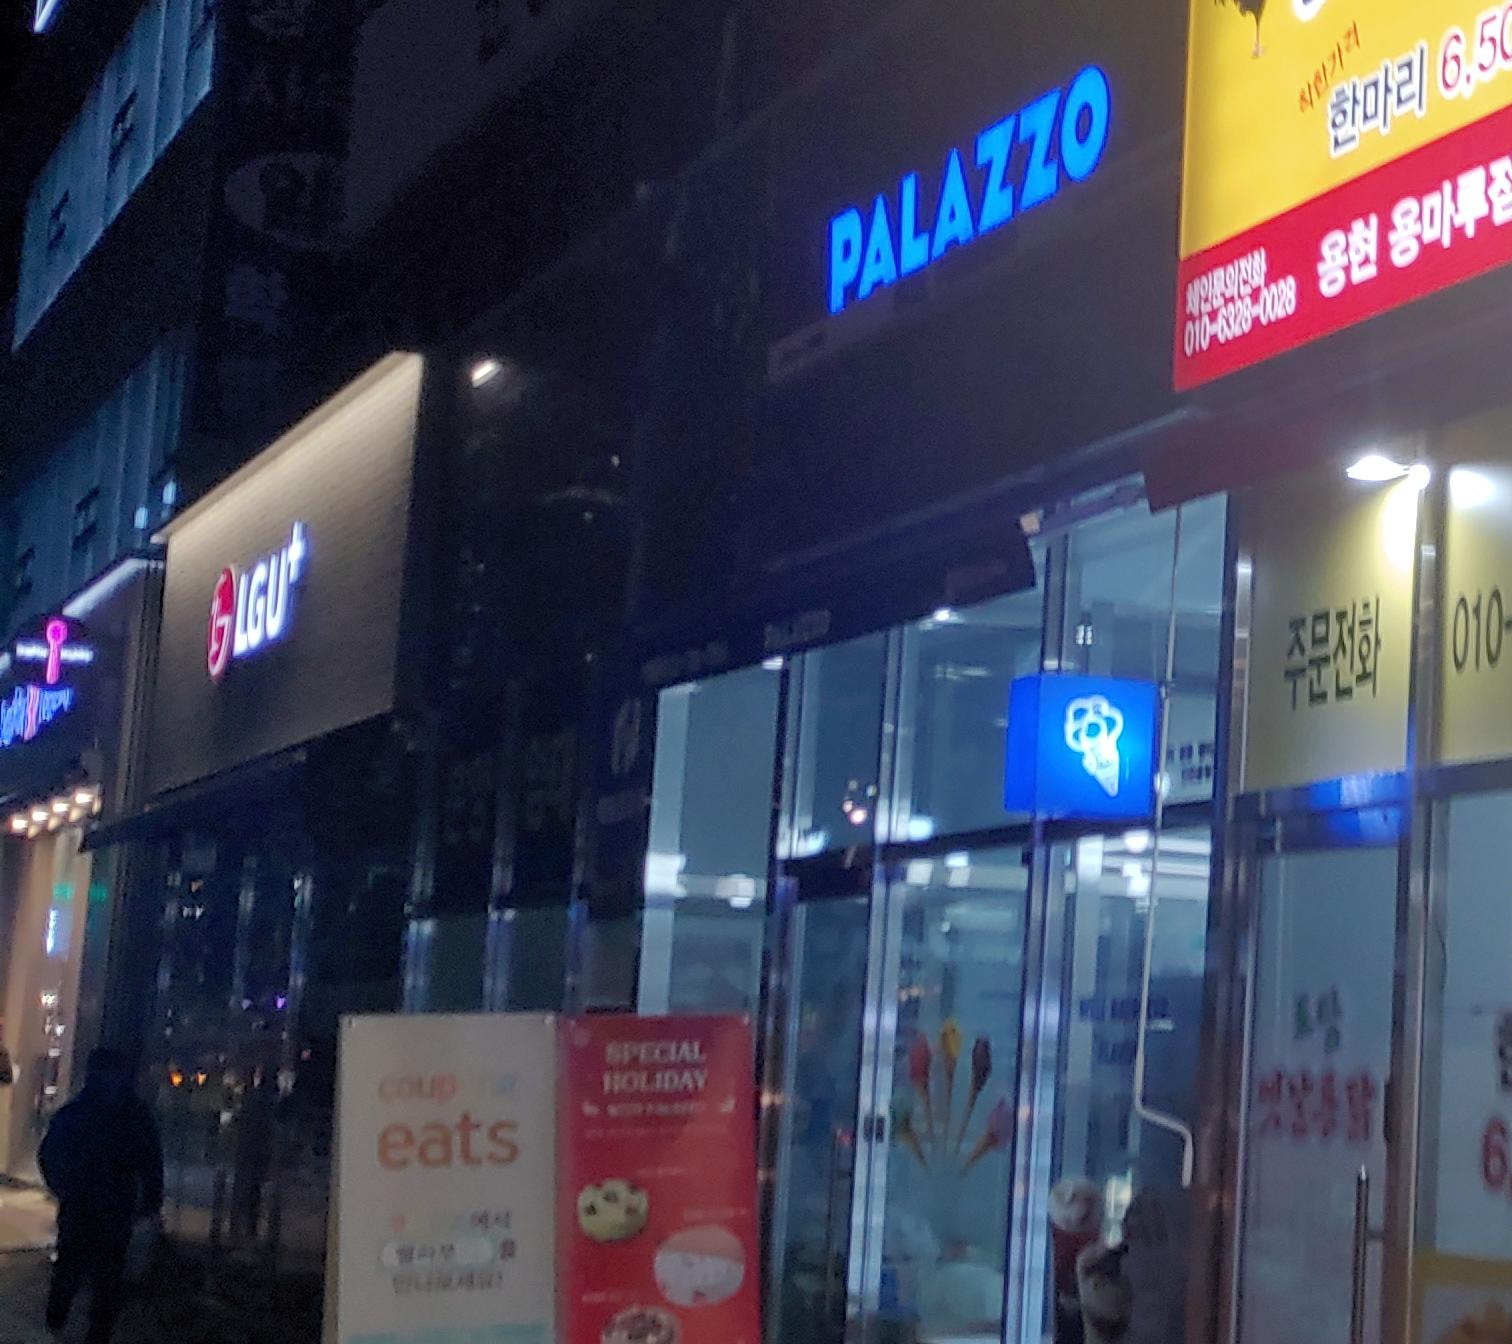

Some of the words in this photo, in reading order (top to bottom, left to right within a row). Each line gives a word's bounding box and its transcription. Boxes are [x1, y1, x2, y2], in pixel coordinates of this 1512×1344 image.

[1327, 45, 1427, 151] 한마리
[827, 63, 1112, 316] PALAZZO
[1316, 211, 1380, 300] 용현
[232, 520, 307, 658] LGU+
[1283, 595, 1381, 711] 주문전화
[601, 1067, 709, 1095] HOLIDAY
[605, 1039, 708, 1065] SPECIAL
[376, 1109, 521, 1171] eats
